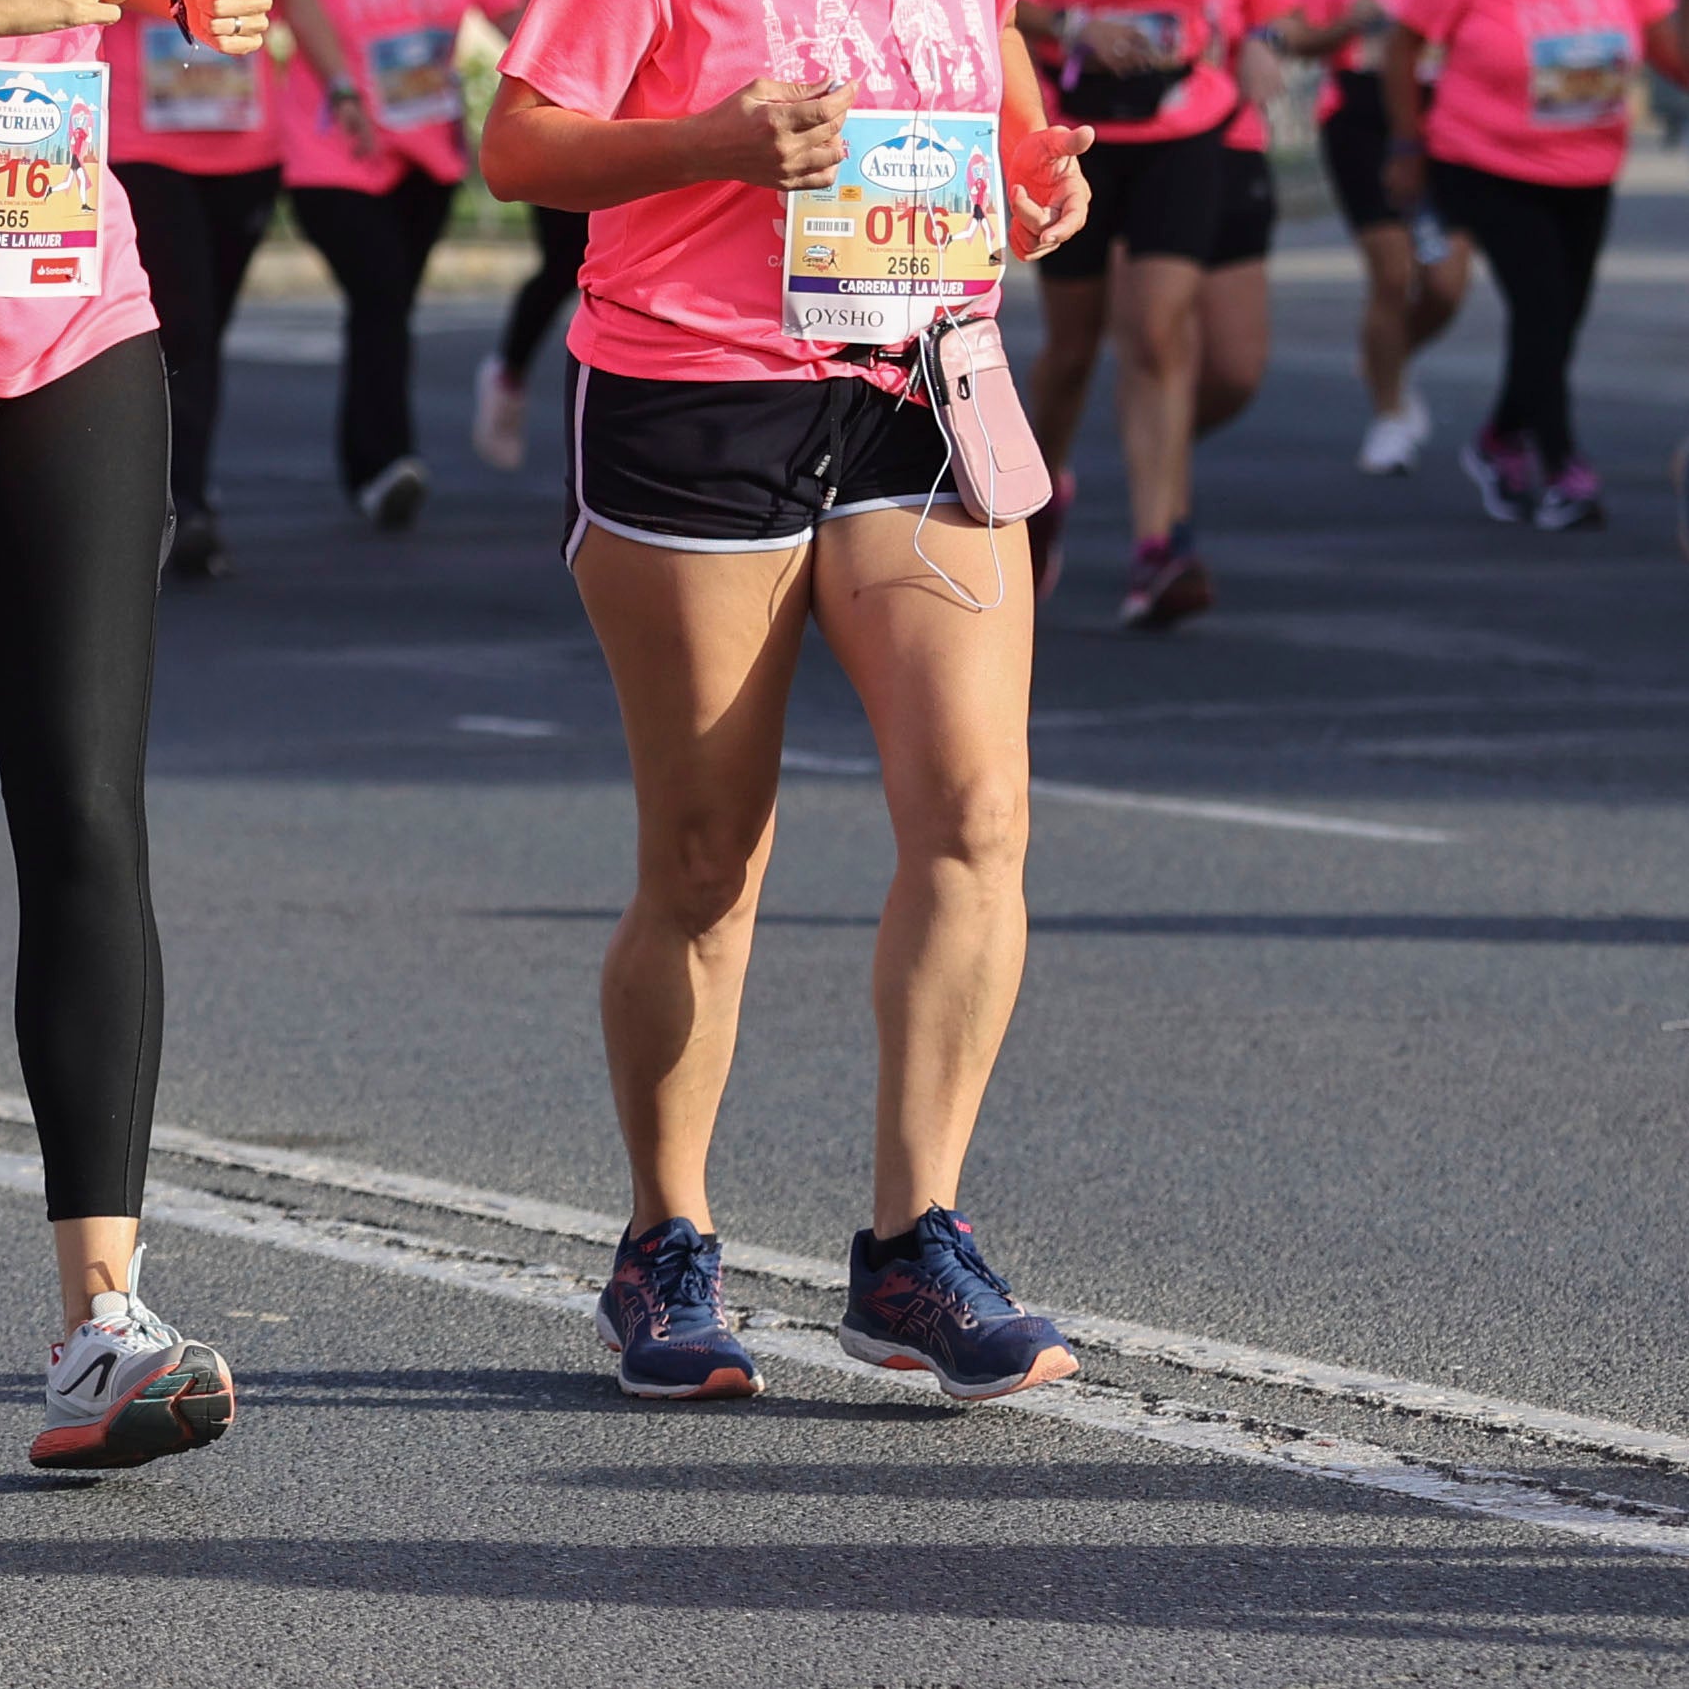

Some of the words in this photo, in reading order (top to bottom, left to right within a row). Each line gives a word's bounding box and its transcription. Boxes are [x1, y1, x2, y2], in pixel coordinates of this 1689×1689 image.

[867, 154, 950, 177] ASTURIANA
[865, 205, 950, 246] 016
[11, 233, 26, 248] LA
[28, 233, 62, 248] MUJER
[887, 257, 930, 275] 2566
[838, 279, 894, 294] CARRERA
[898, 281, 912, 295] DE
[915, 281, 928, 295] LA
[931, 281, 964, 296] MUJER
[805, 307, 884, 328] OYSHO
